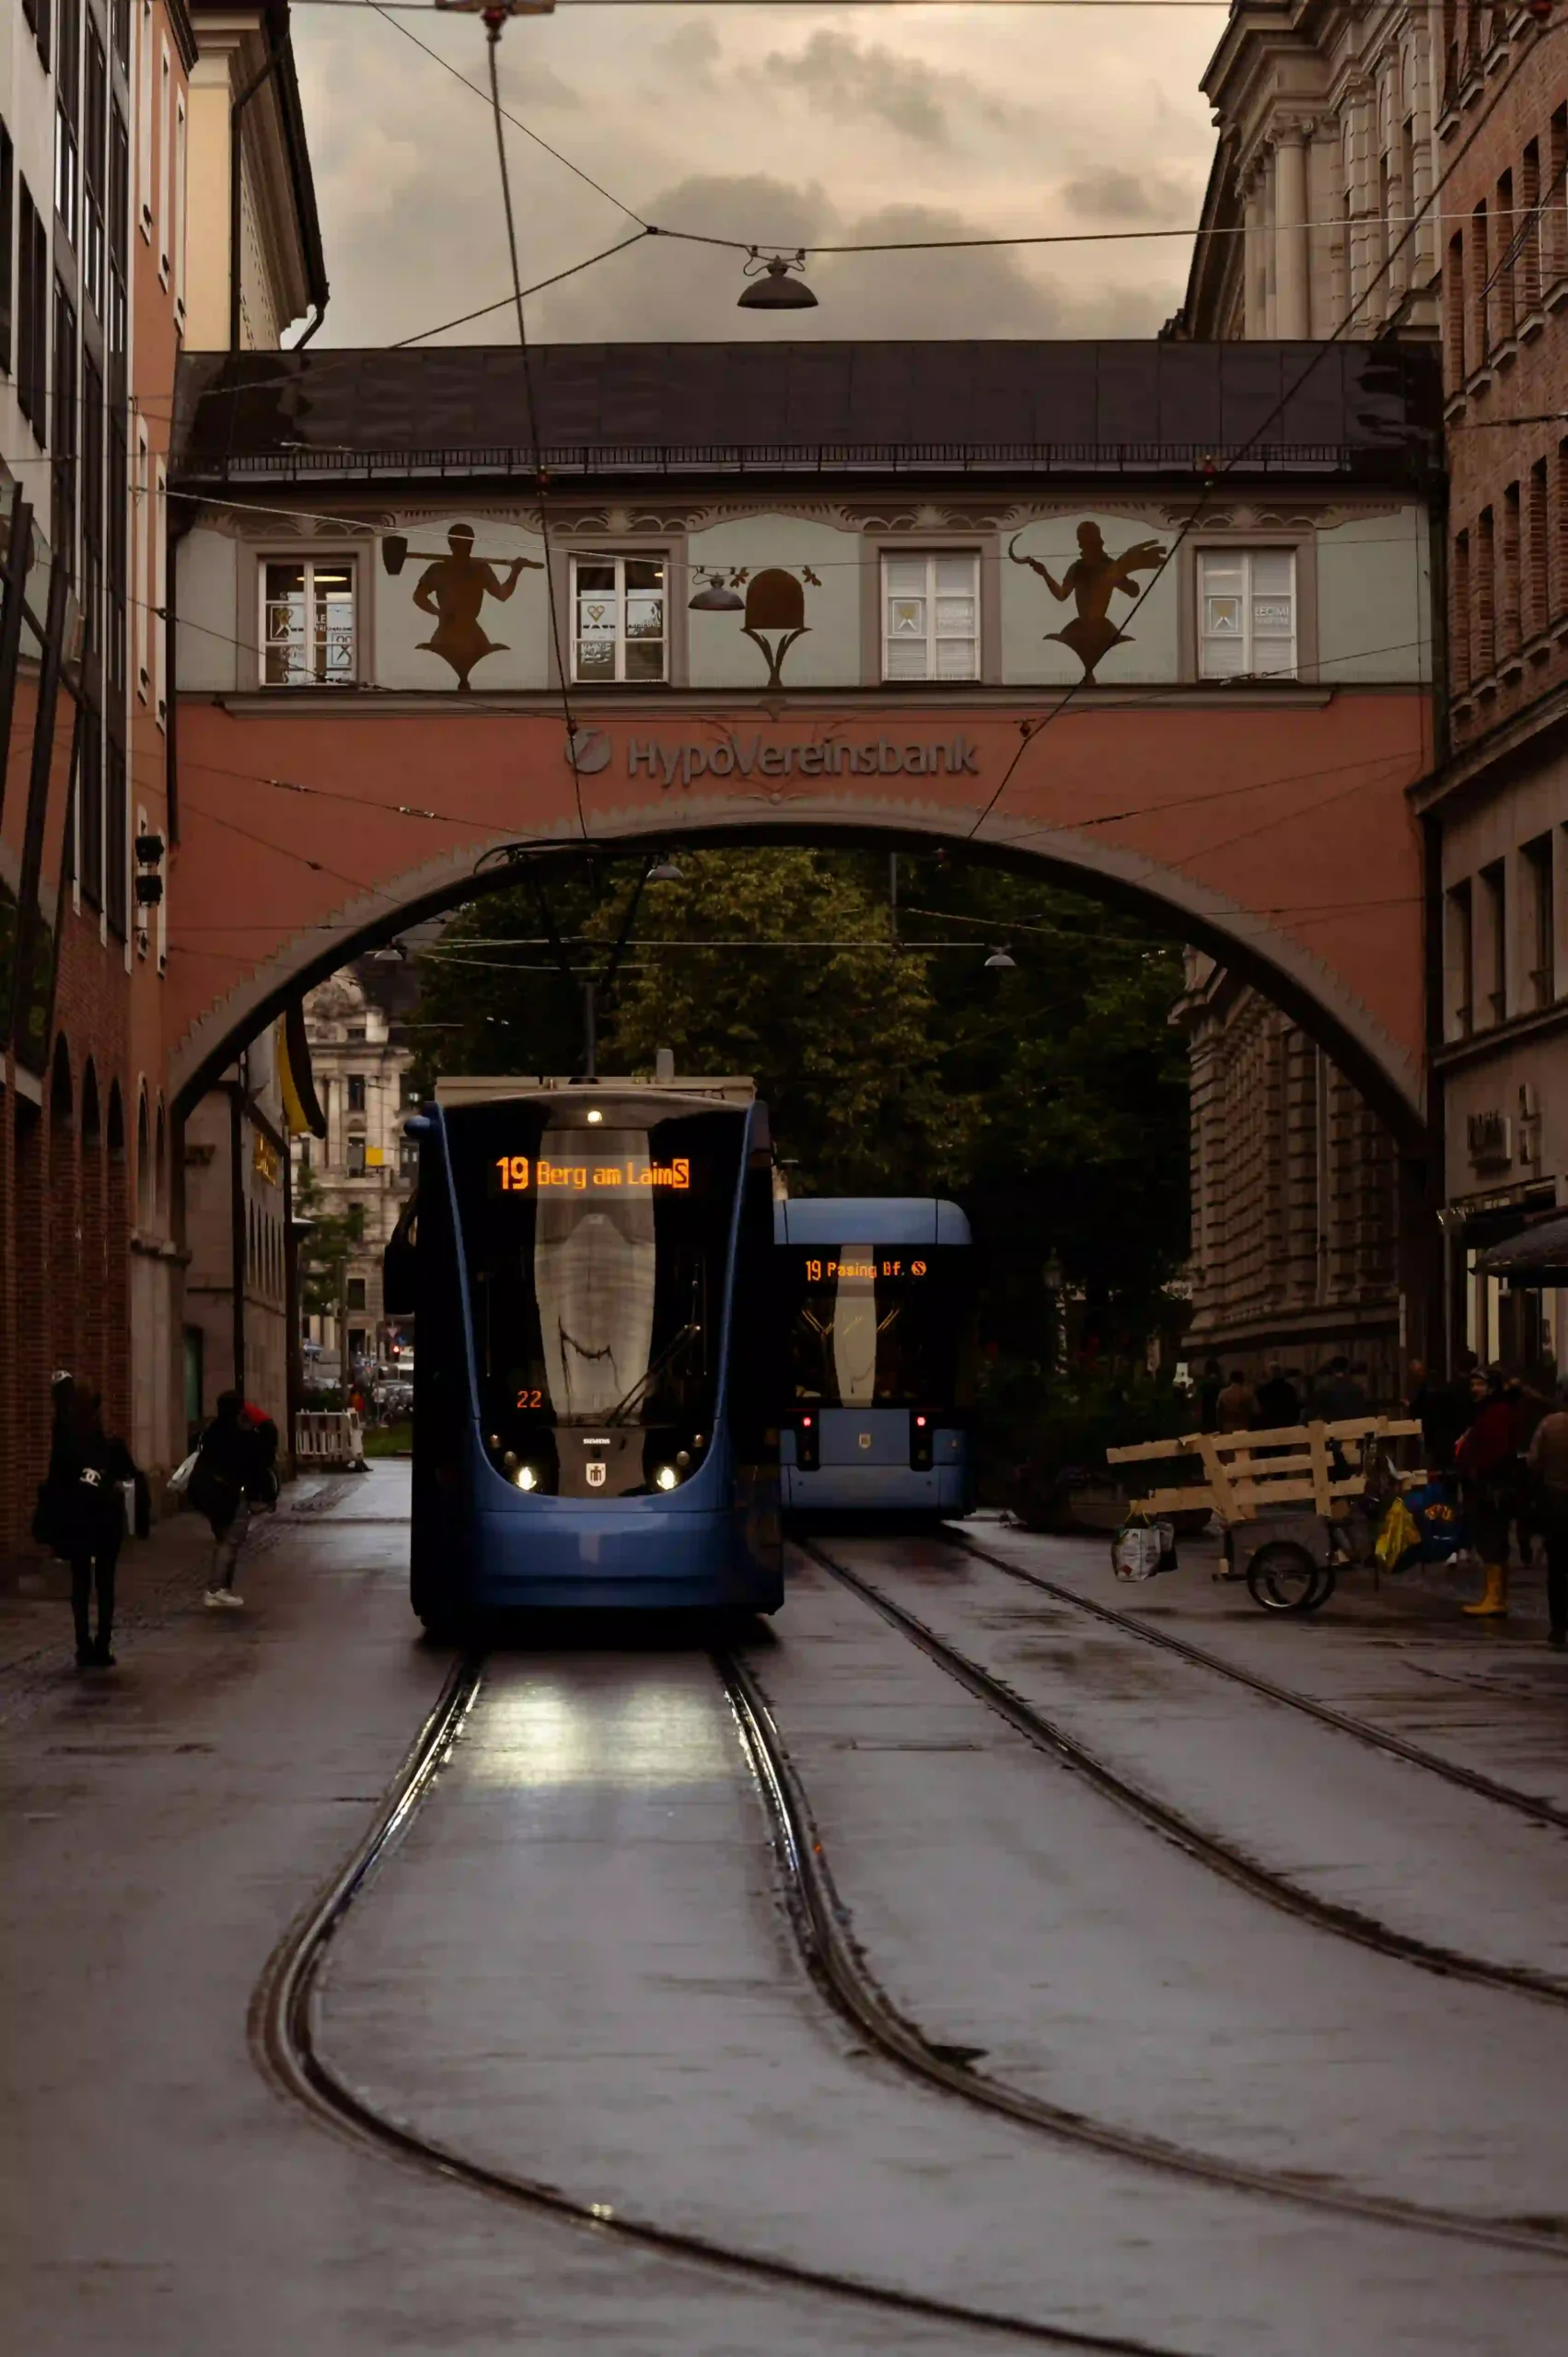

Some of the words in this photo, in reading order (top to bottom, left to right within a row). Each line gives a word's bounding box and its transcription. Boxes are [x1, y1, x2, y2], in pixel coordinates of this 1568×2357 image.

[627, 735, 979, 788] HypoVereinsbank
[495, 1156, 528, 1190] 19
[537, 1161, 587, 1190] Berg
[593, 1167, 621, 1186] am
[805, 1260, 821, 1282] 19
[827, 1261, 877, 1279] Pasing
[517, 1390, 541, 1408] 22
